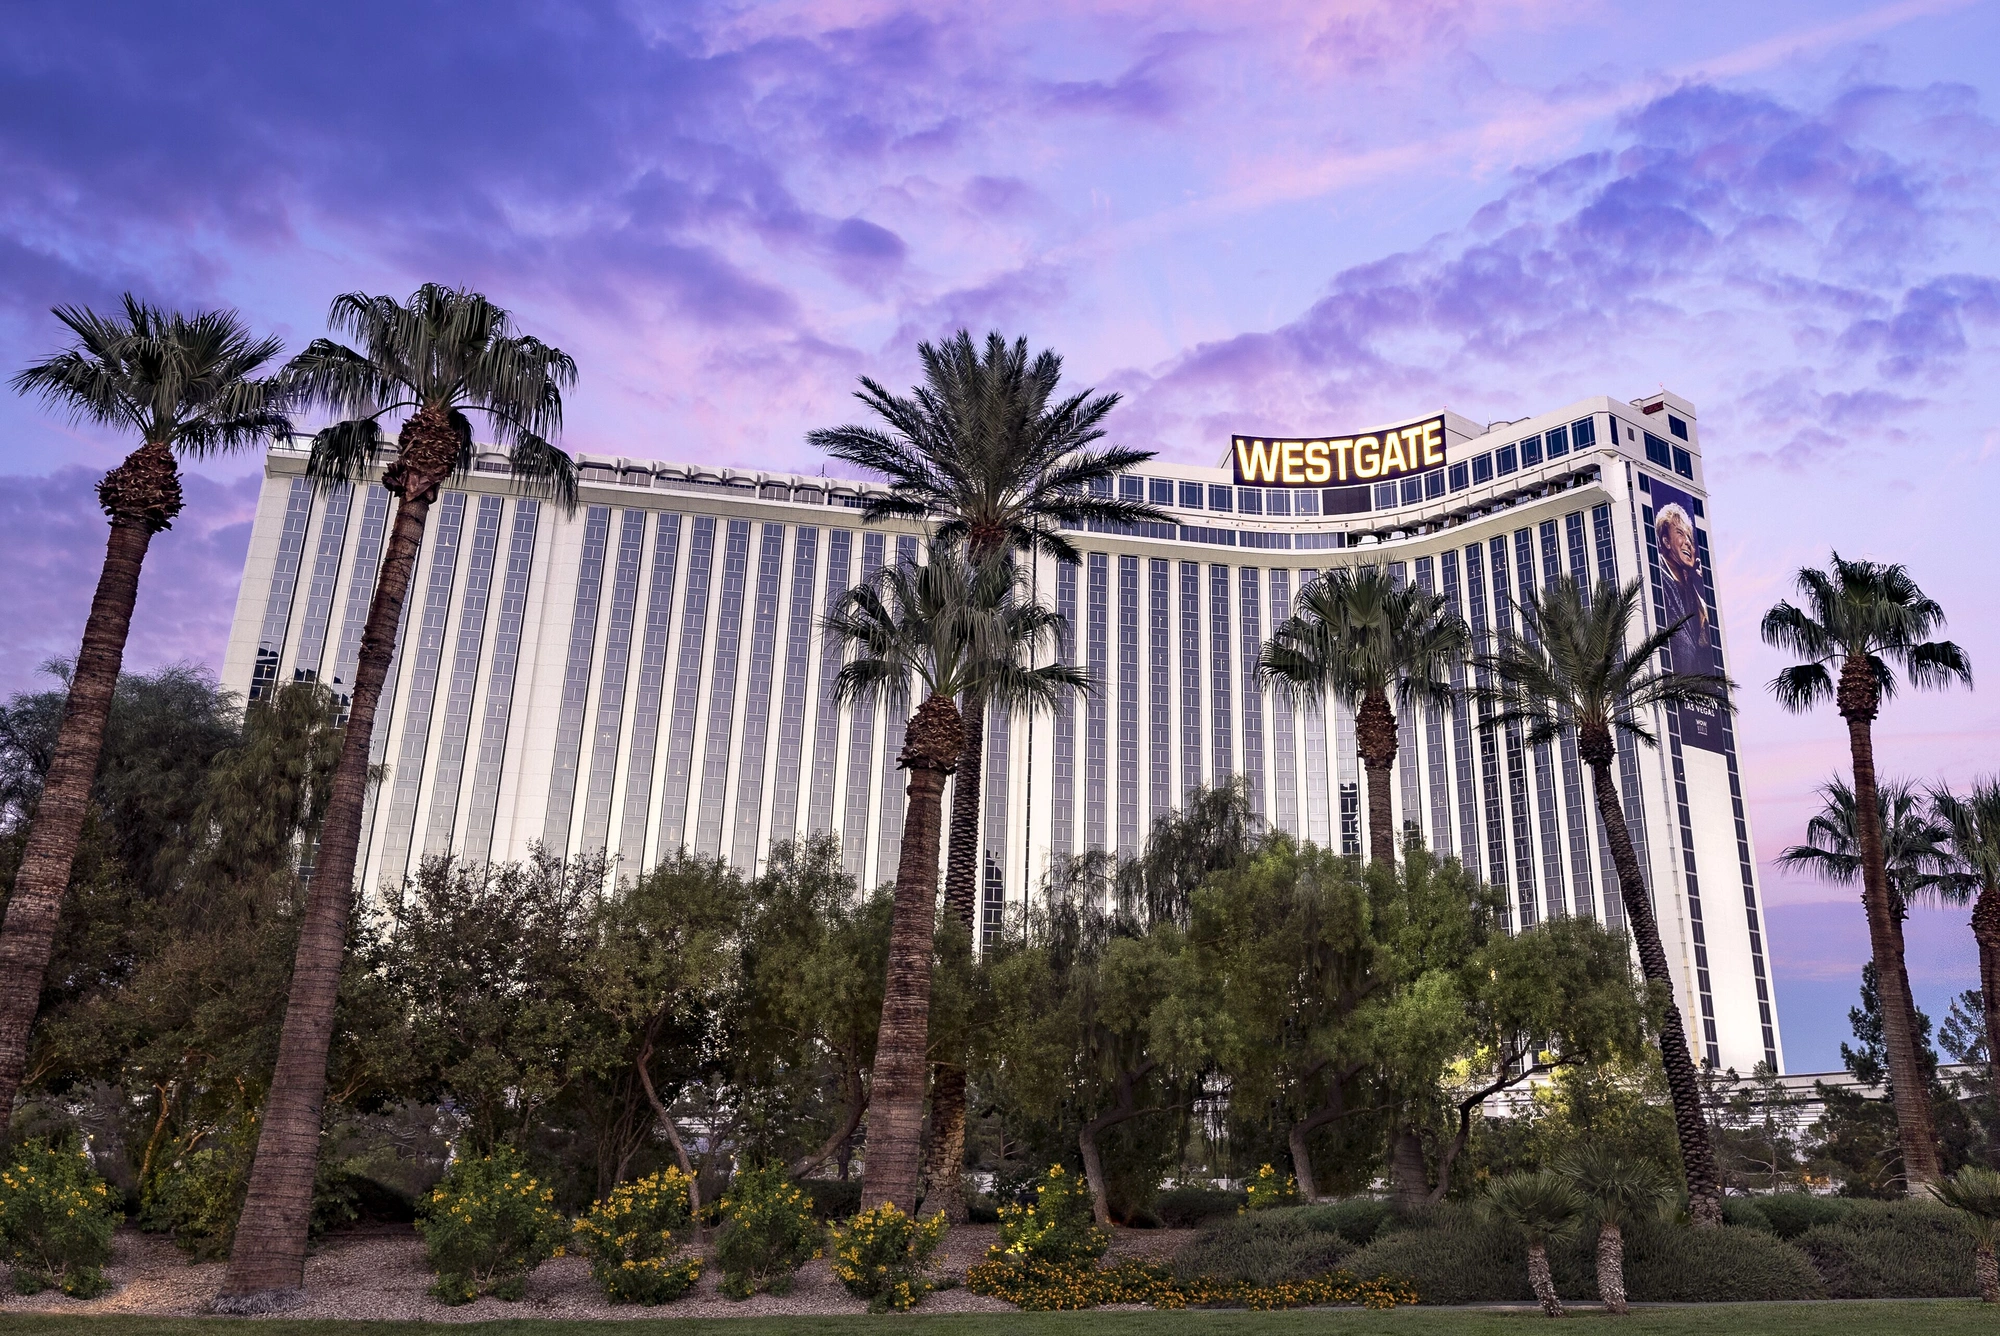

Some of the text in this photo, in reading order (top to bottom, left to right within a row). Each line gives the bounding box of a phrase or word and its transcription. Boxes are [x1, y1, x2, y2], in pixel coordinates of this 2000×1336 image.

[1235, 419, 1444, 483] WESTGATE
[1684, 702, 1715, 717] LAS VEGAS
